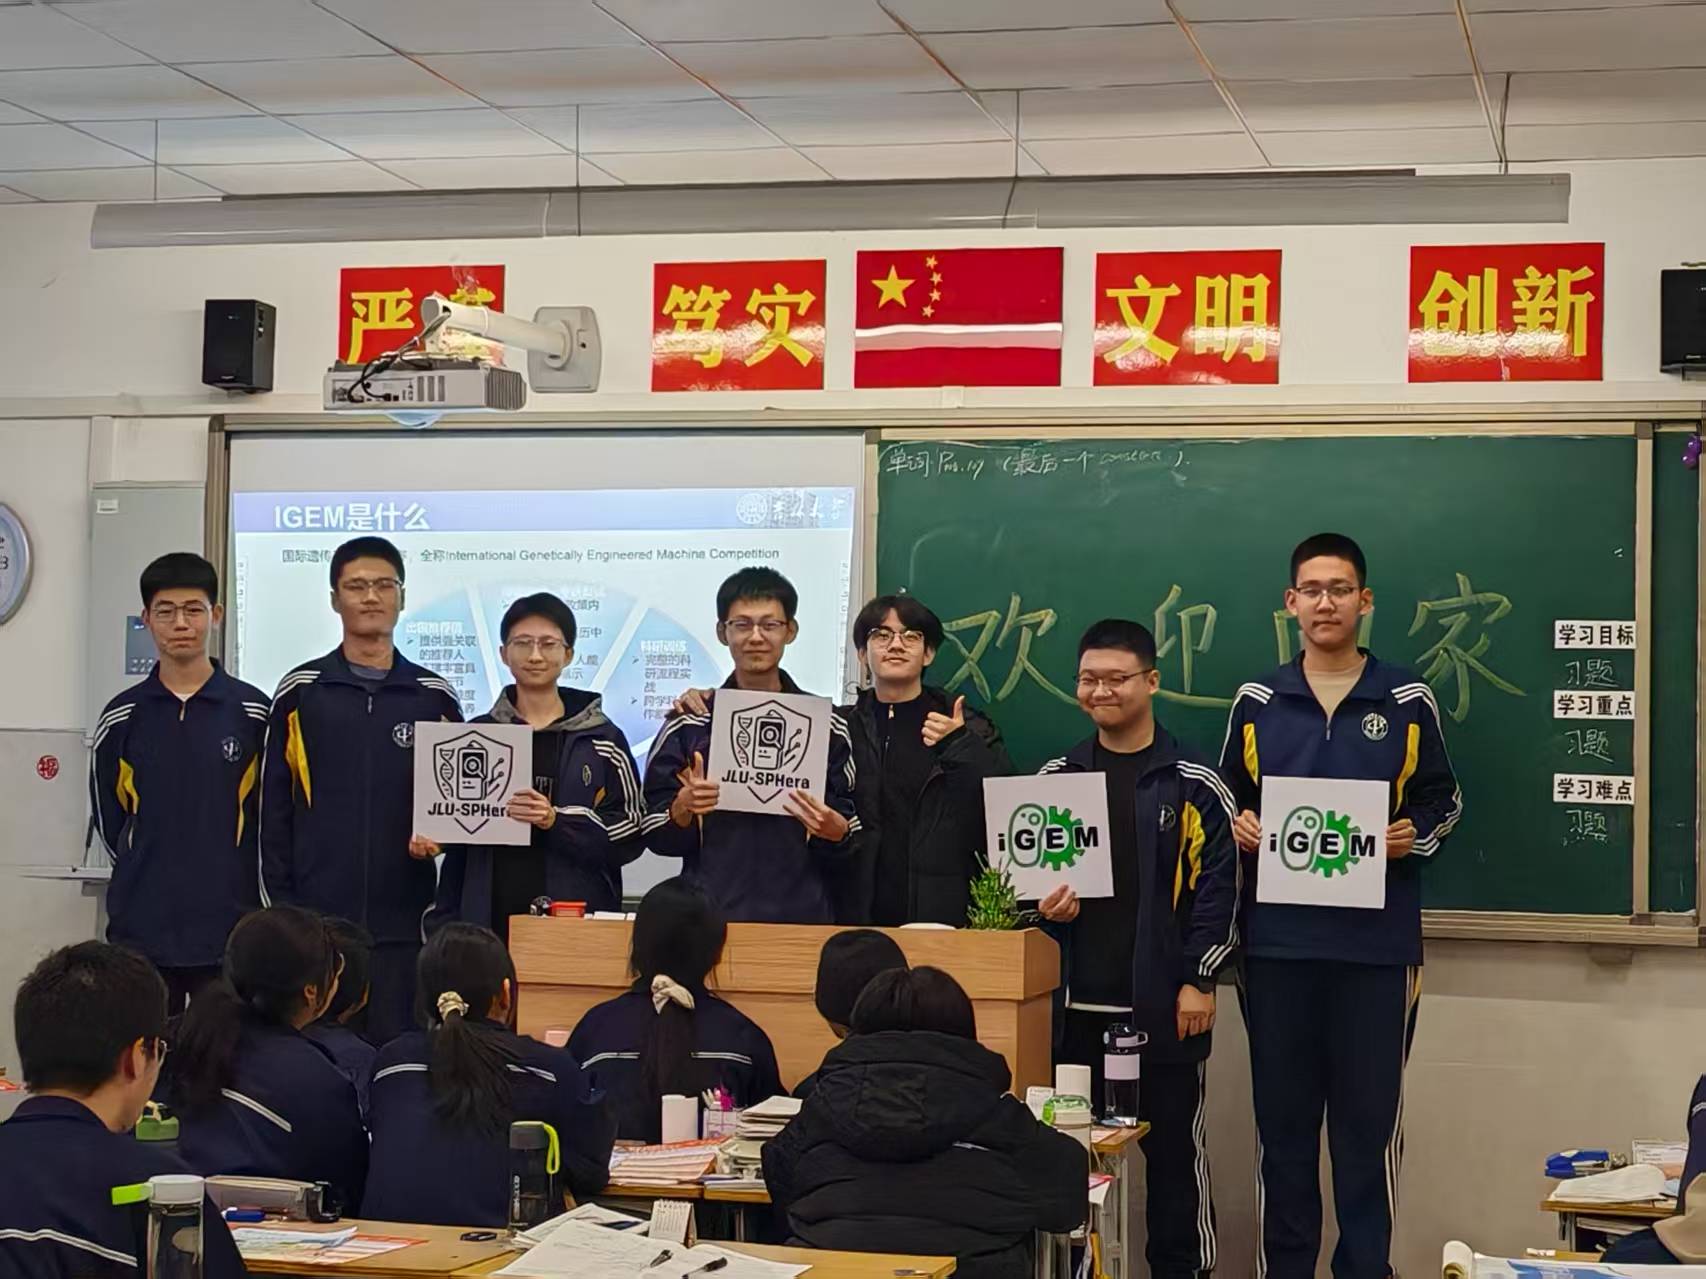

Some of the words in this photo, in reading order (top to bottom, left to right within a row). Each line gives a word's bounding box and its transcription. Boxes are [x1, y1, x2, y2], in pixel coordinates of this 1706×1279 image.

[1104, 273, 1273, 364] 文明
[1418, 265, 1597, 357] 创新
[346, 287, 497, 366] 严
[662, 283, 817, 369] 笃实
[274, 502, 431, 531] IGEM是什么
[519, 550, 584, 563] Genetically
[587, 549, 653, 563] Engineered
[709, 548, 780, 562] Competition
[1559, 625, 1635, 645] 学习目标
[1557, 695, 1633, 716] 学习重点
[721, 768, 811, 790] JLU-SPHera
[1557, 777, 1633, 801] 学习难点
[998, 826, 1099, 851] iGEM
[1269, 832, 1376, 858] iGEM
